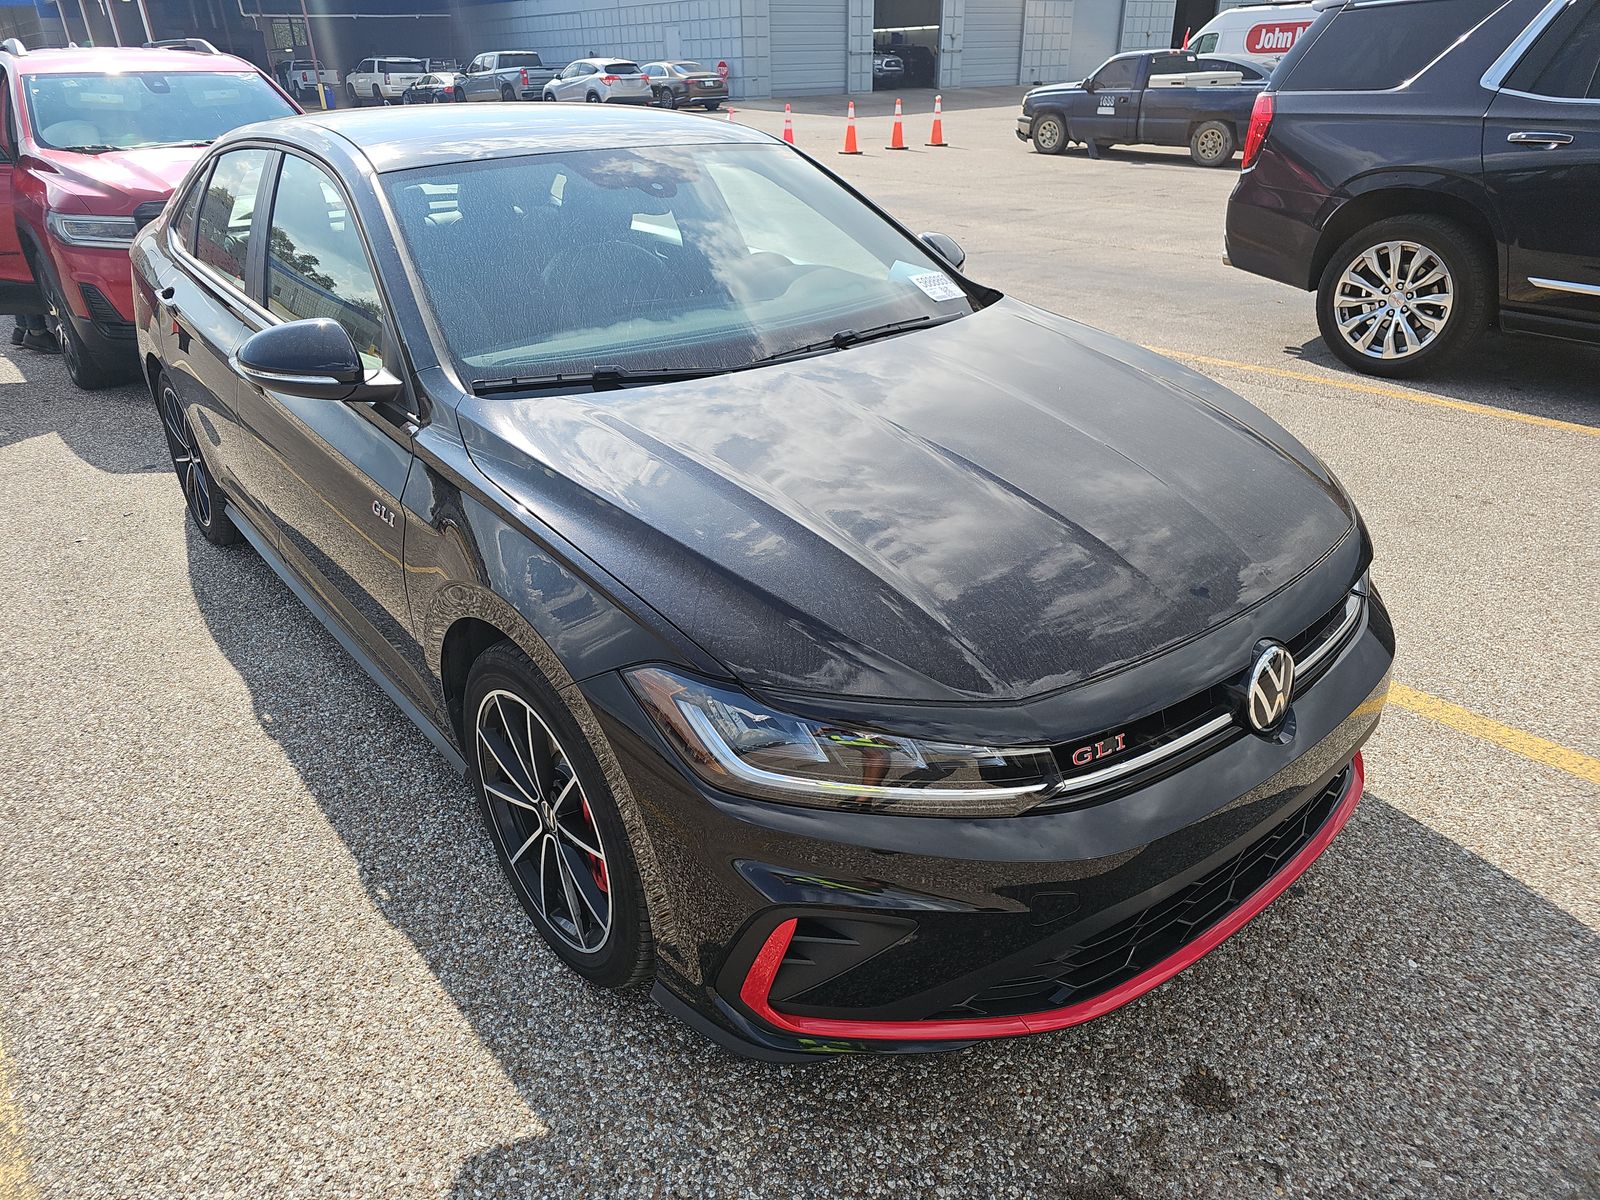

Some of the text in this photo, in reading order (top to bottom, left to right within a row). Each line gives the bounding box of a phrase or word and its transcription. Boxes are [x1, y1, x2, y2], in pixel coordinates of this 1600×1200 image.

[1255, 27, 1293, 49] John
[372, 500, 395, 527] GLI
[1072, 732, 1126, 766] GLI
